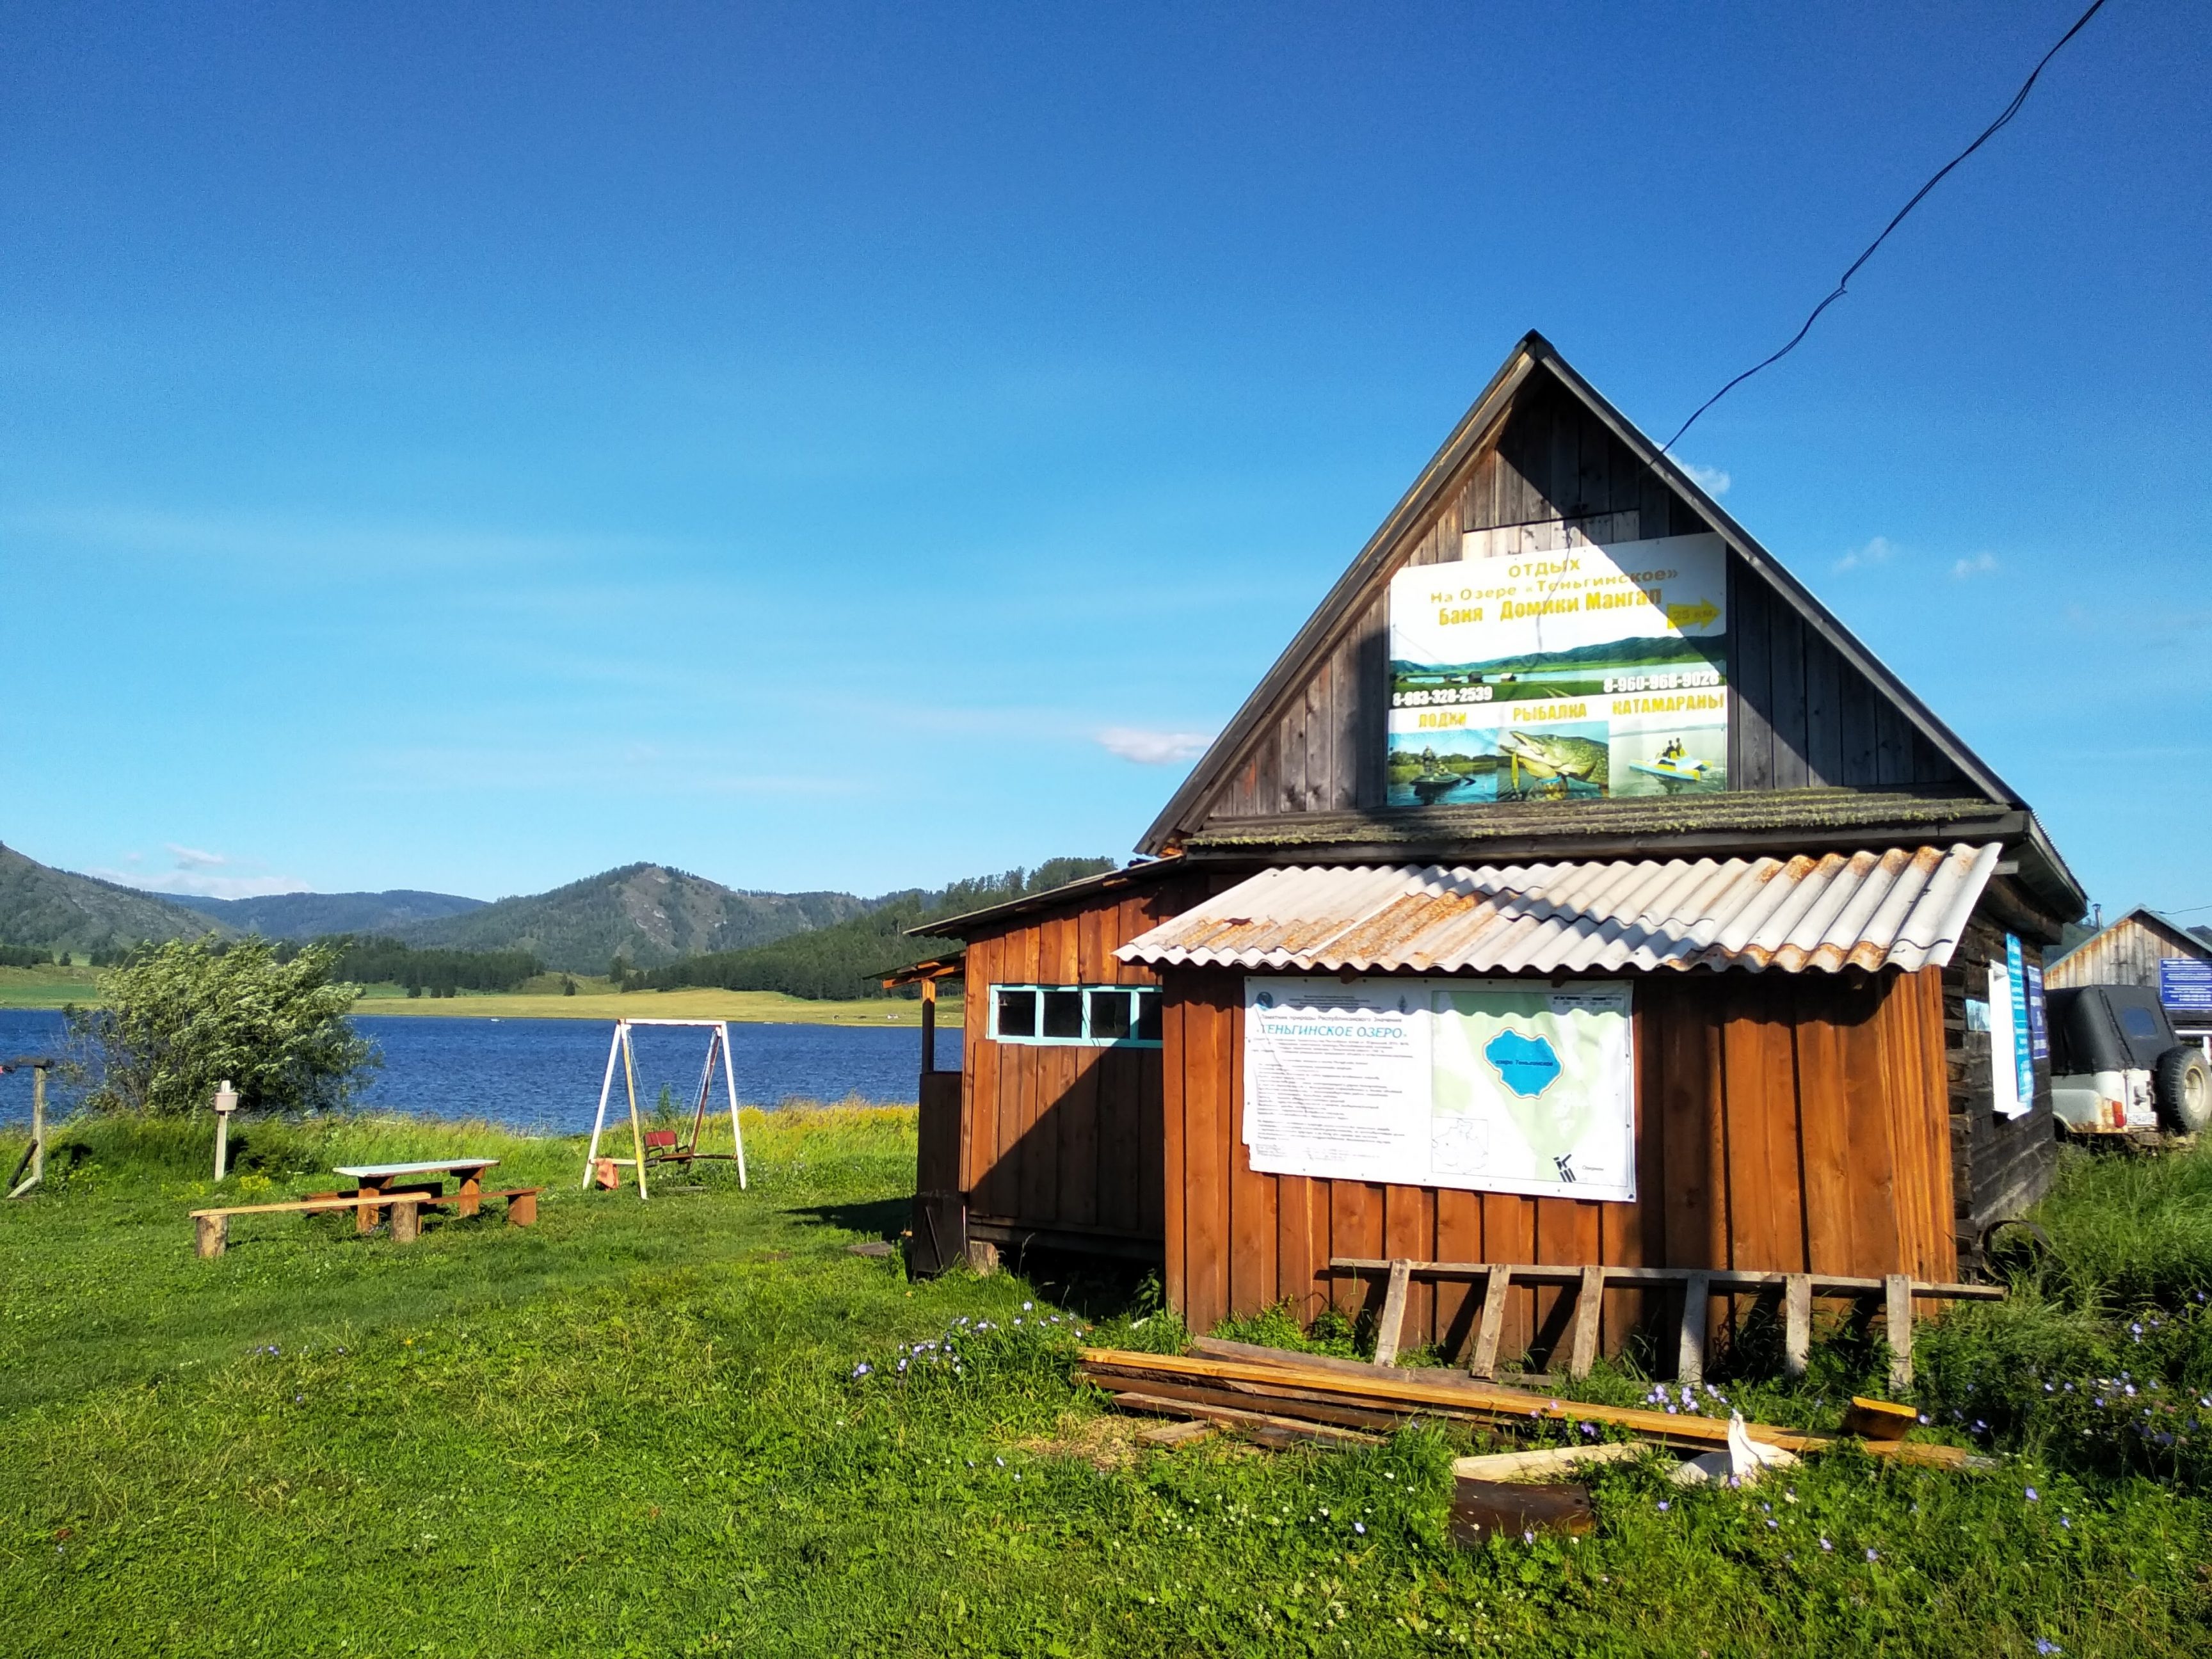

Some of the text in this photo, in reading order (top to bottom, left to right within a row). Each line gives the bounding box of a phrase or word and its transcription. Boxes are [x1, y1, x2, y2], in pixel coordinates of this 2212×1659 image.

[1509, 559, 1580, 577] ОТДЫХ
[1431, 592, 1453, 603] На
[1439, 588, 1662, 625] Баня Домики Мангал
[1513, 703, 1587, 721] РЫБАЛКА
[1612, 693, 1724, 715] КАТАМАРАНЫ
[1419, 711, 1466, 728] ЛОДКИ
